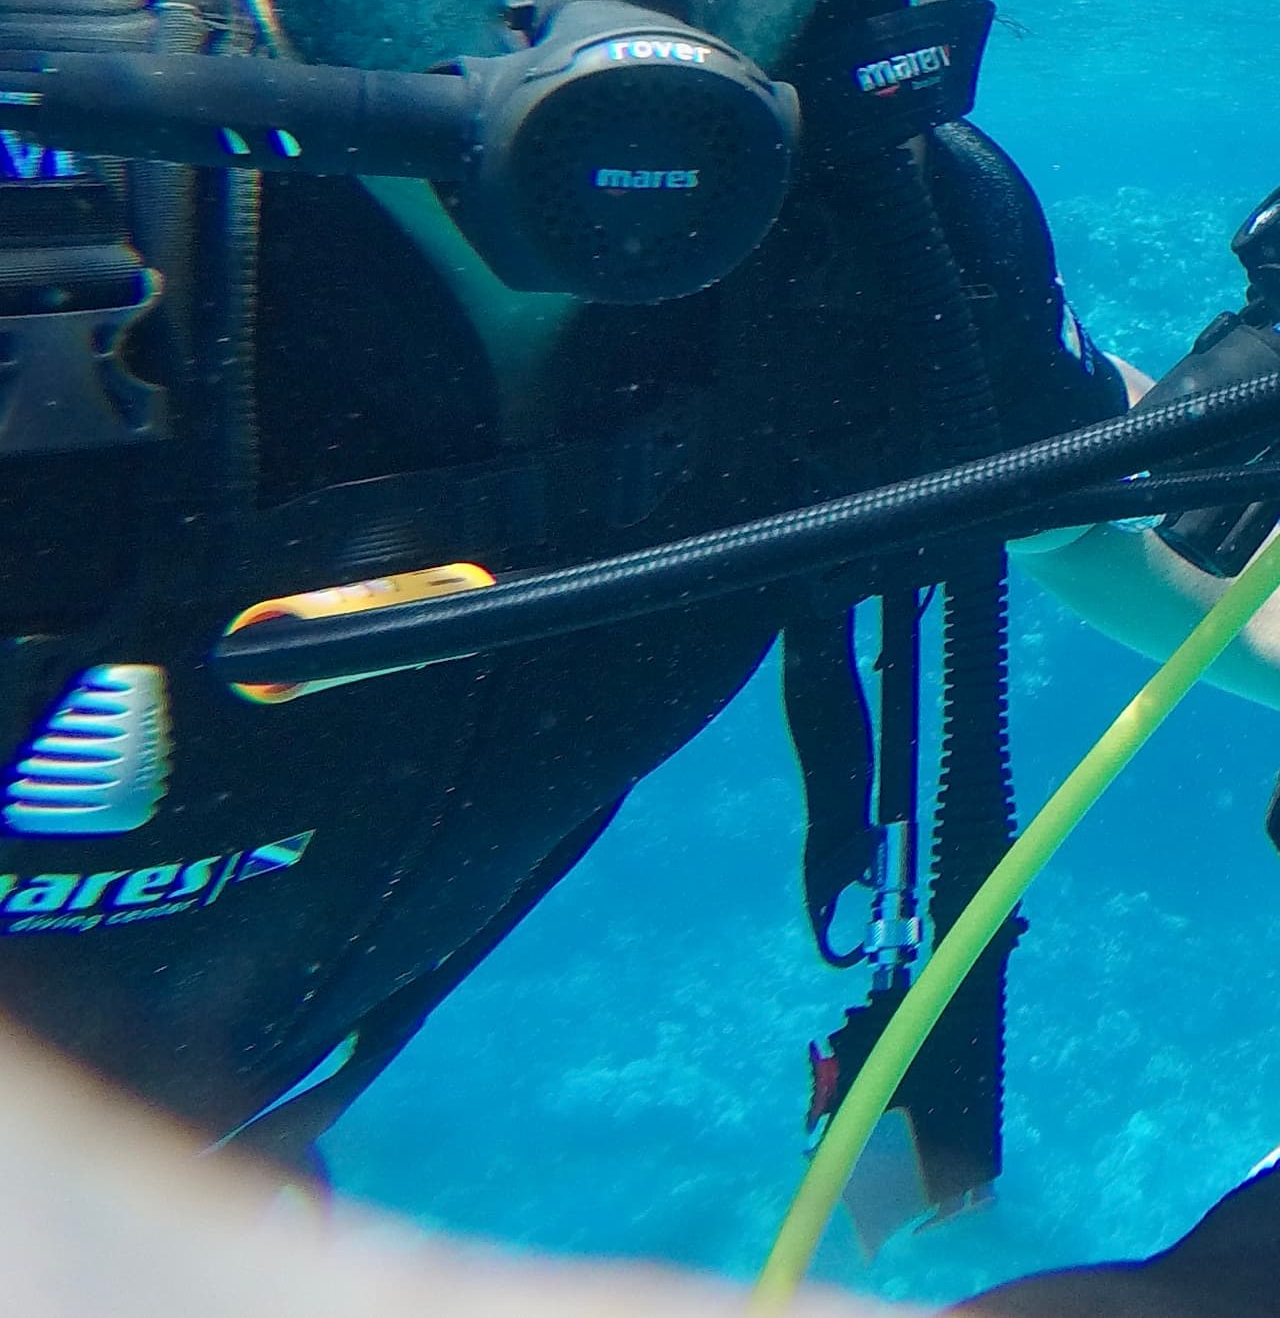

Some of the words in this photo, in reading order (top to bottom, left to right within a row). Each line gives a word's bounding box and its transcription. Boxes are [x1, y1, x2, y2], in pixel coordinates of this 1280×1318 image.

[608, 40, 711, 63] rover
[595, 167, 700, 189] mares
[0, 855, 222, 911] ares
